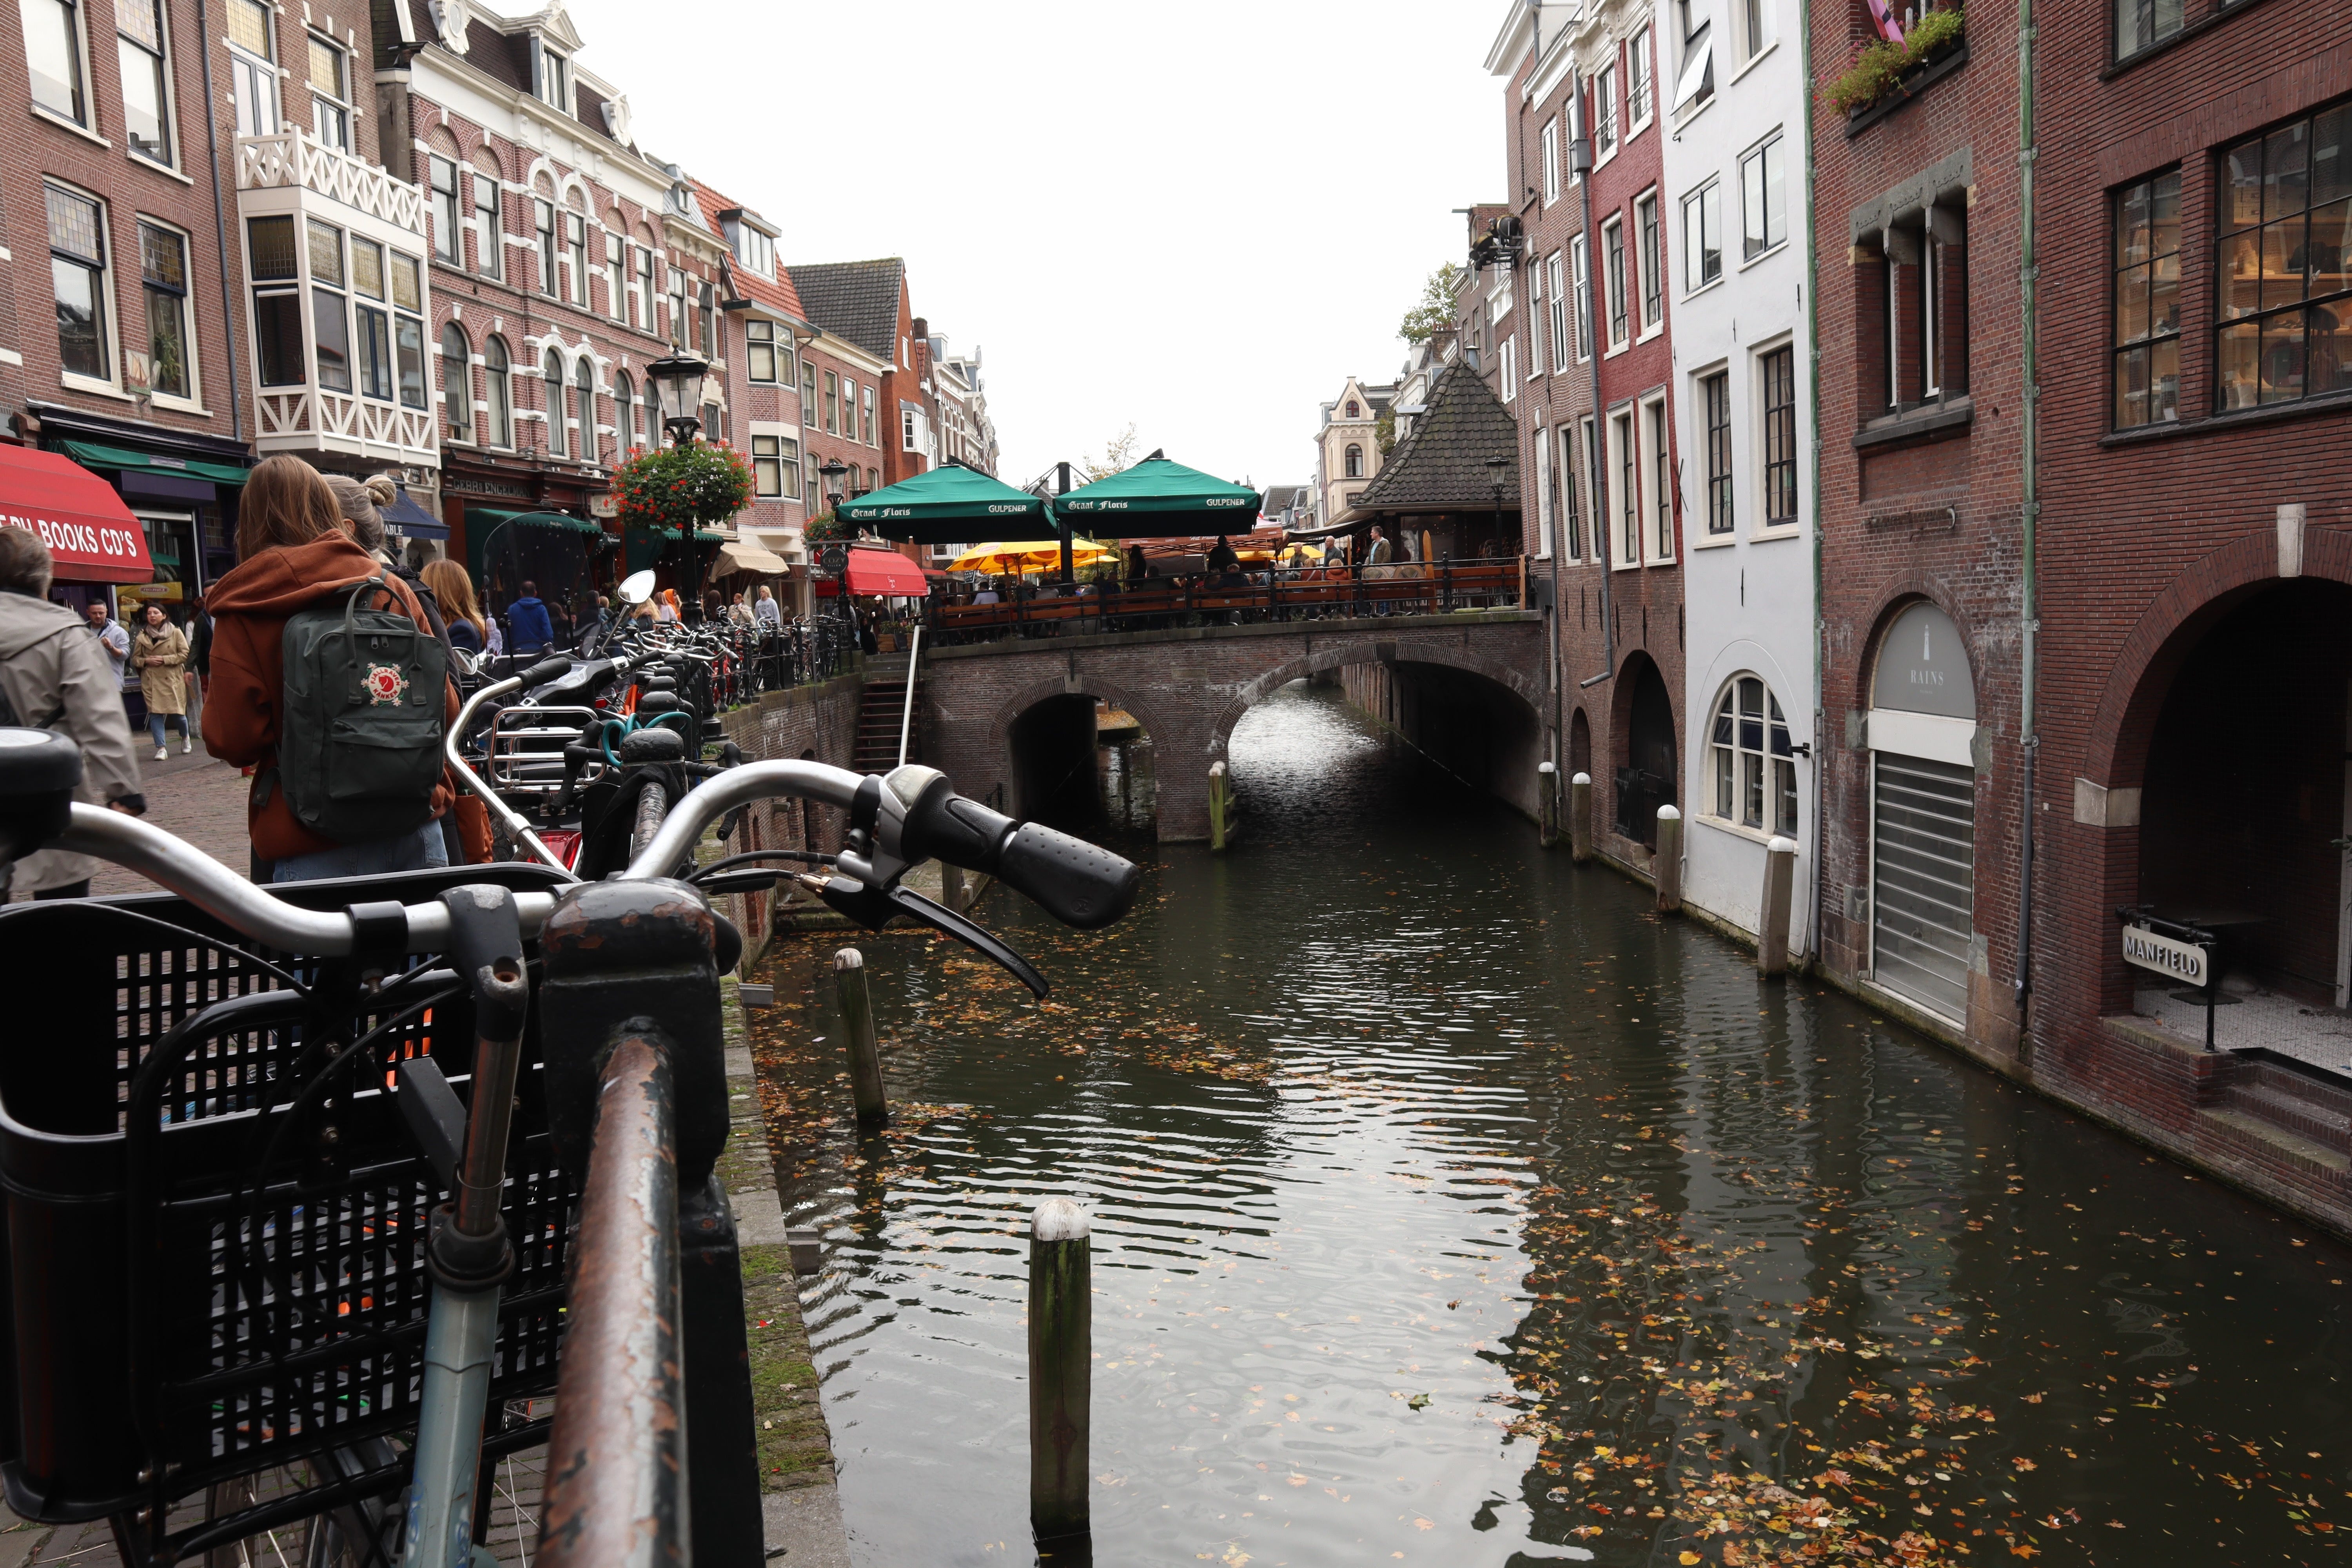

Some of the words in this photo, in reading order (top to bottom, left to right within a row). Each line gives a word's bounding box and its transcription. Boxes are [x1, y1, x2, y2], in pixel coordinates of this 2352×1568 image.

[485, 482, 530, 497] ENGELMAN
[851, 508, 876, 517] Graaf
[880, 507, 910, 518] Floris
[1068, 501, 1094, 510] Graaf
[1098, 500, 1128, 510] Floris
[37, 519, 98, 554] BOOKS
[100, 528, 137, 557] CD'S
[1911, 670, 1944, 686] RAINS
[2125, 936, 2198, 975] MANFIELD
